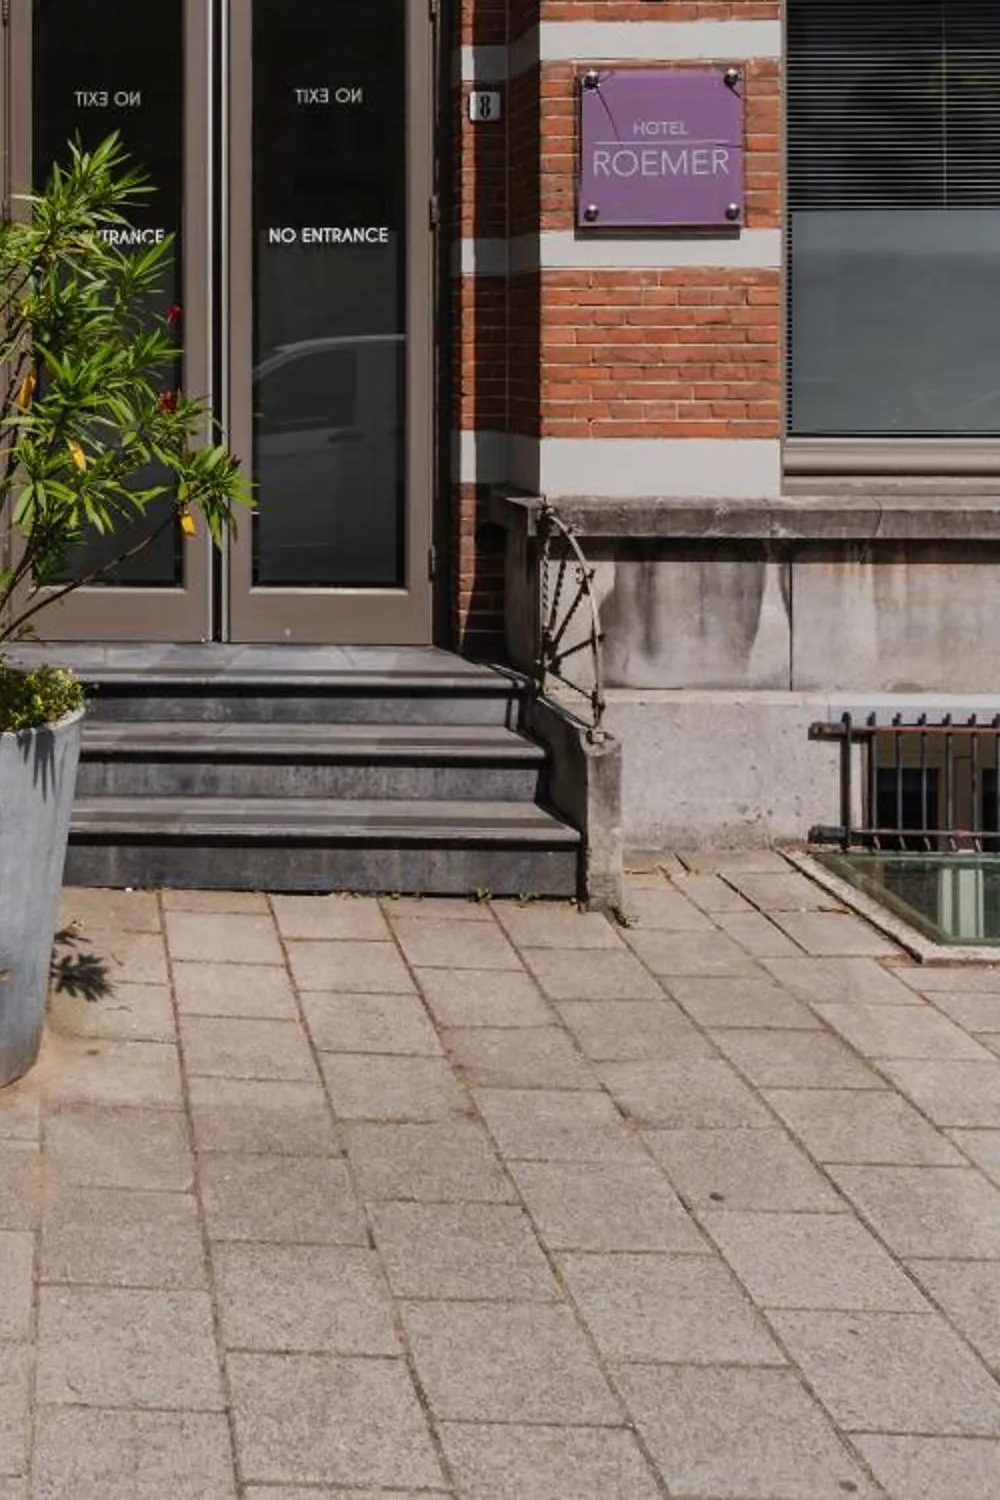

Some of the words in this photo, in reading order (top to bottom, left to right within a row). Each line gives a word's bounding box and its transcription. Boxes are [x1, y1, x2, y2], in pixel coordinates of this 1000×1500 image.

[480, 95, 491, 117] 8
[633, 121, 689, 135] HOTEL
[593, 150, 730, 176] ROEMER
[93, 228, 165, 245] TRANCE
[268, 227, 297, 243] NO
[301, 227, 389, 243] ENTRANCE
